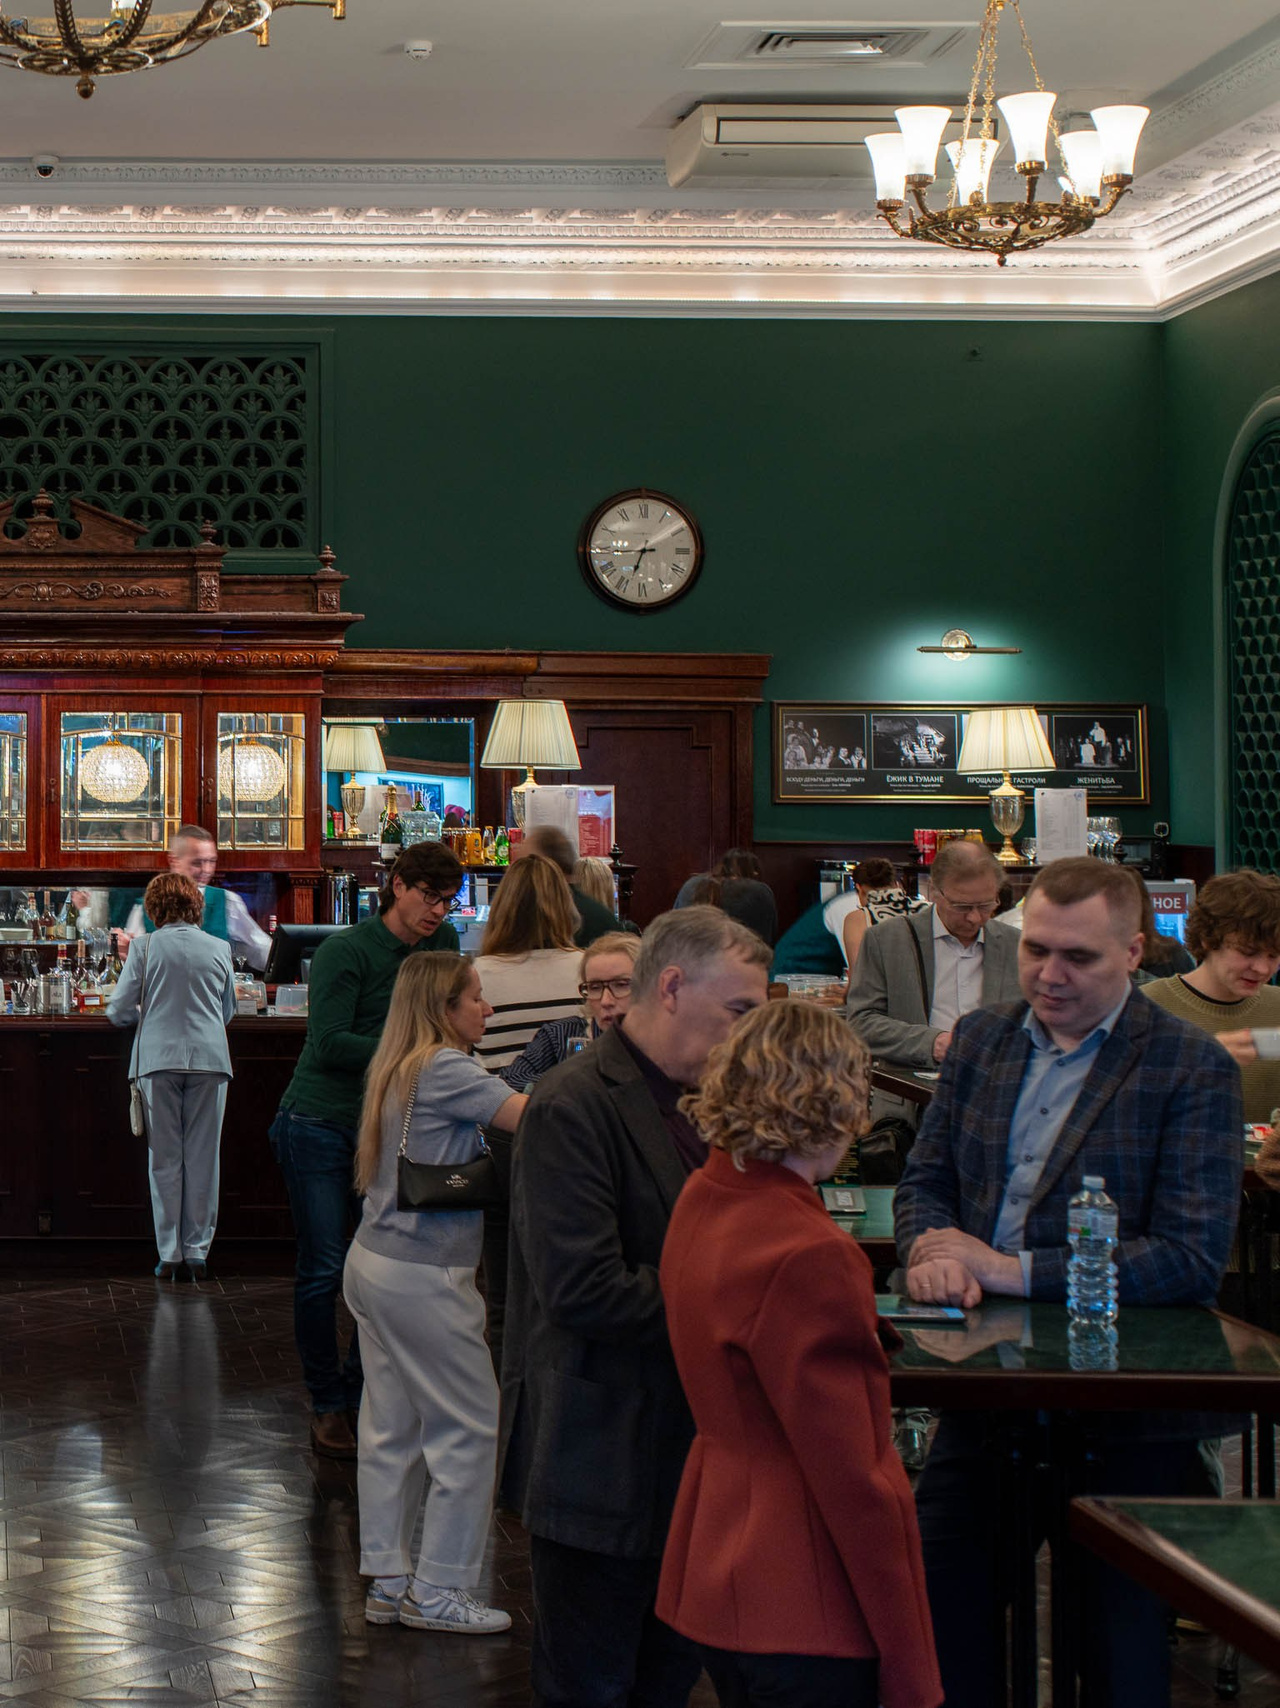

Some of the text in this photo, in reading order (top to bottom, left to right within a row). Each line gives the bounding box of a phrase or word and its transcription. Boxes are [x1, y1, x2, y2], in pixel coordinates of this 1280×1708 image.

[886, 774, 908, 783] ЁЖИК
[915, 775, 944, 783] ТУМАНЕ
[1077, 776, 1116, 784] ЖЕНИТЬБА
